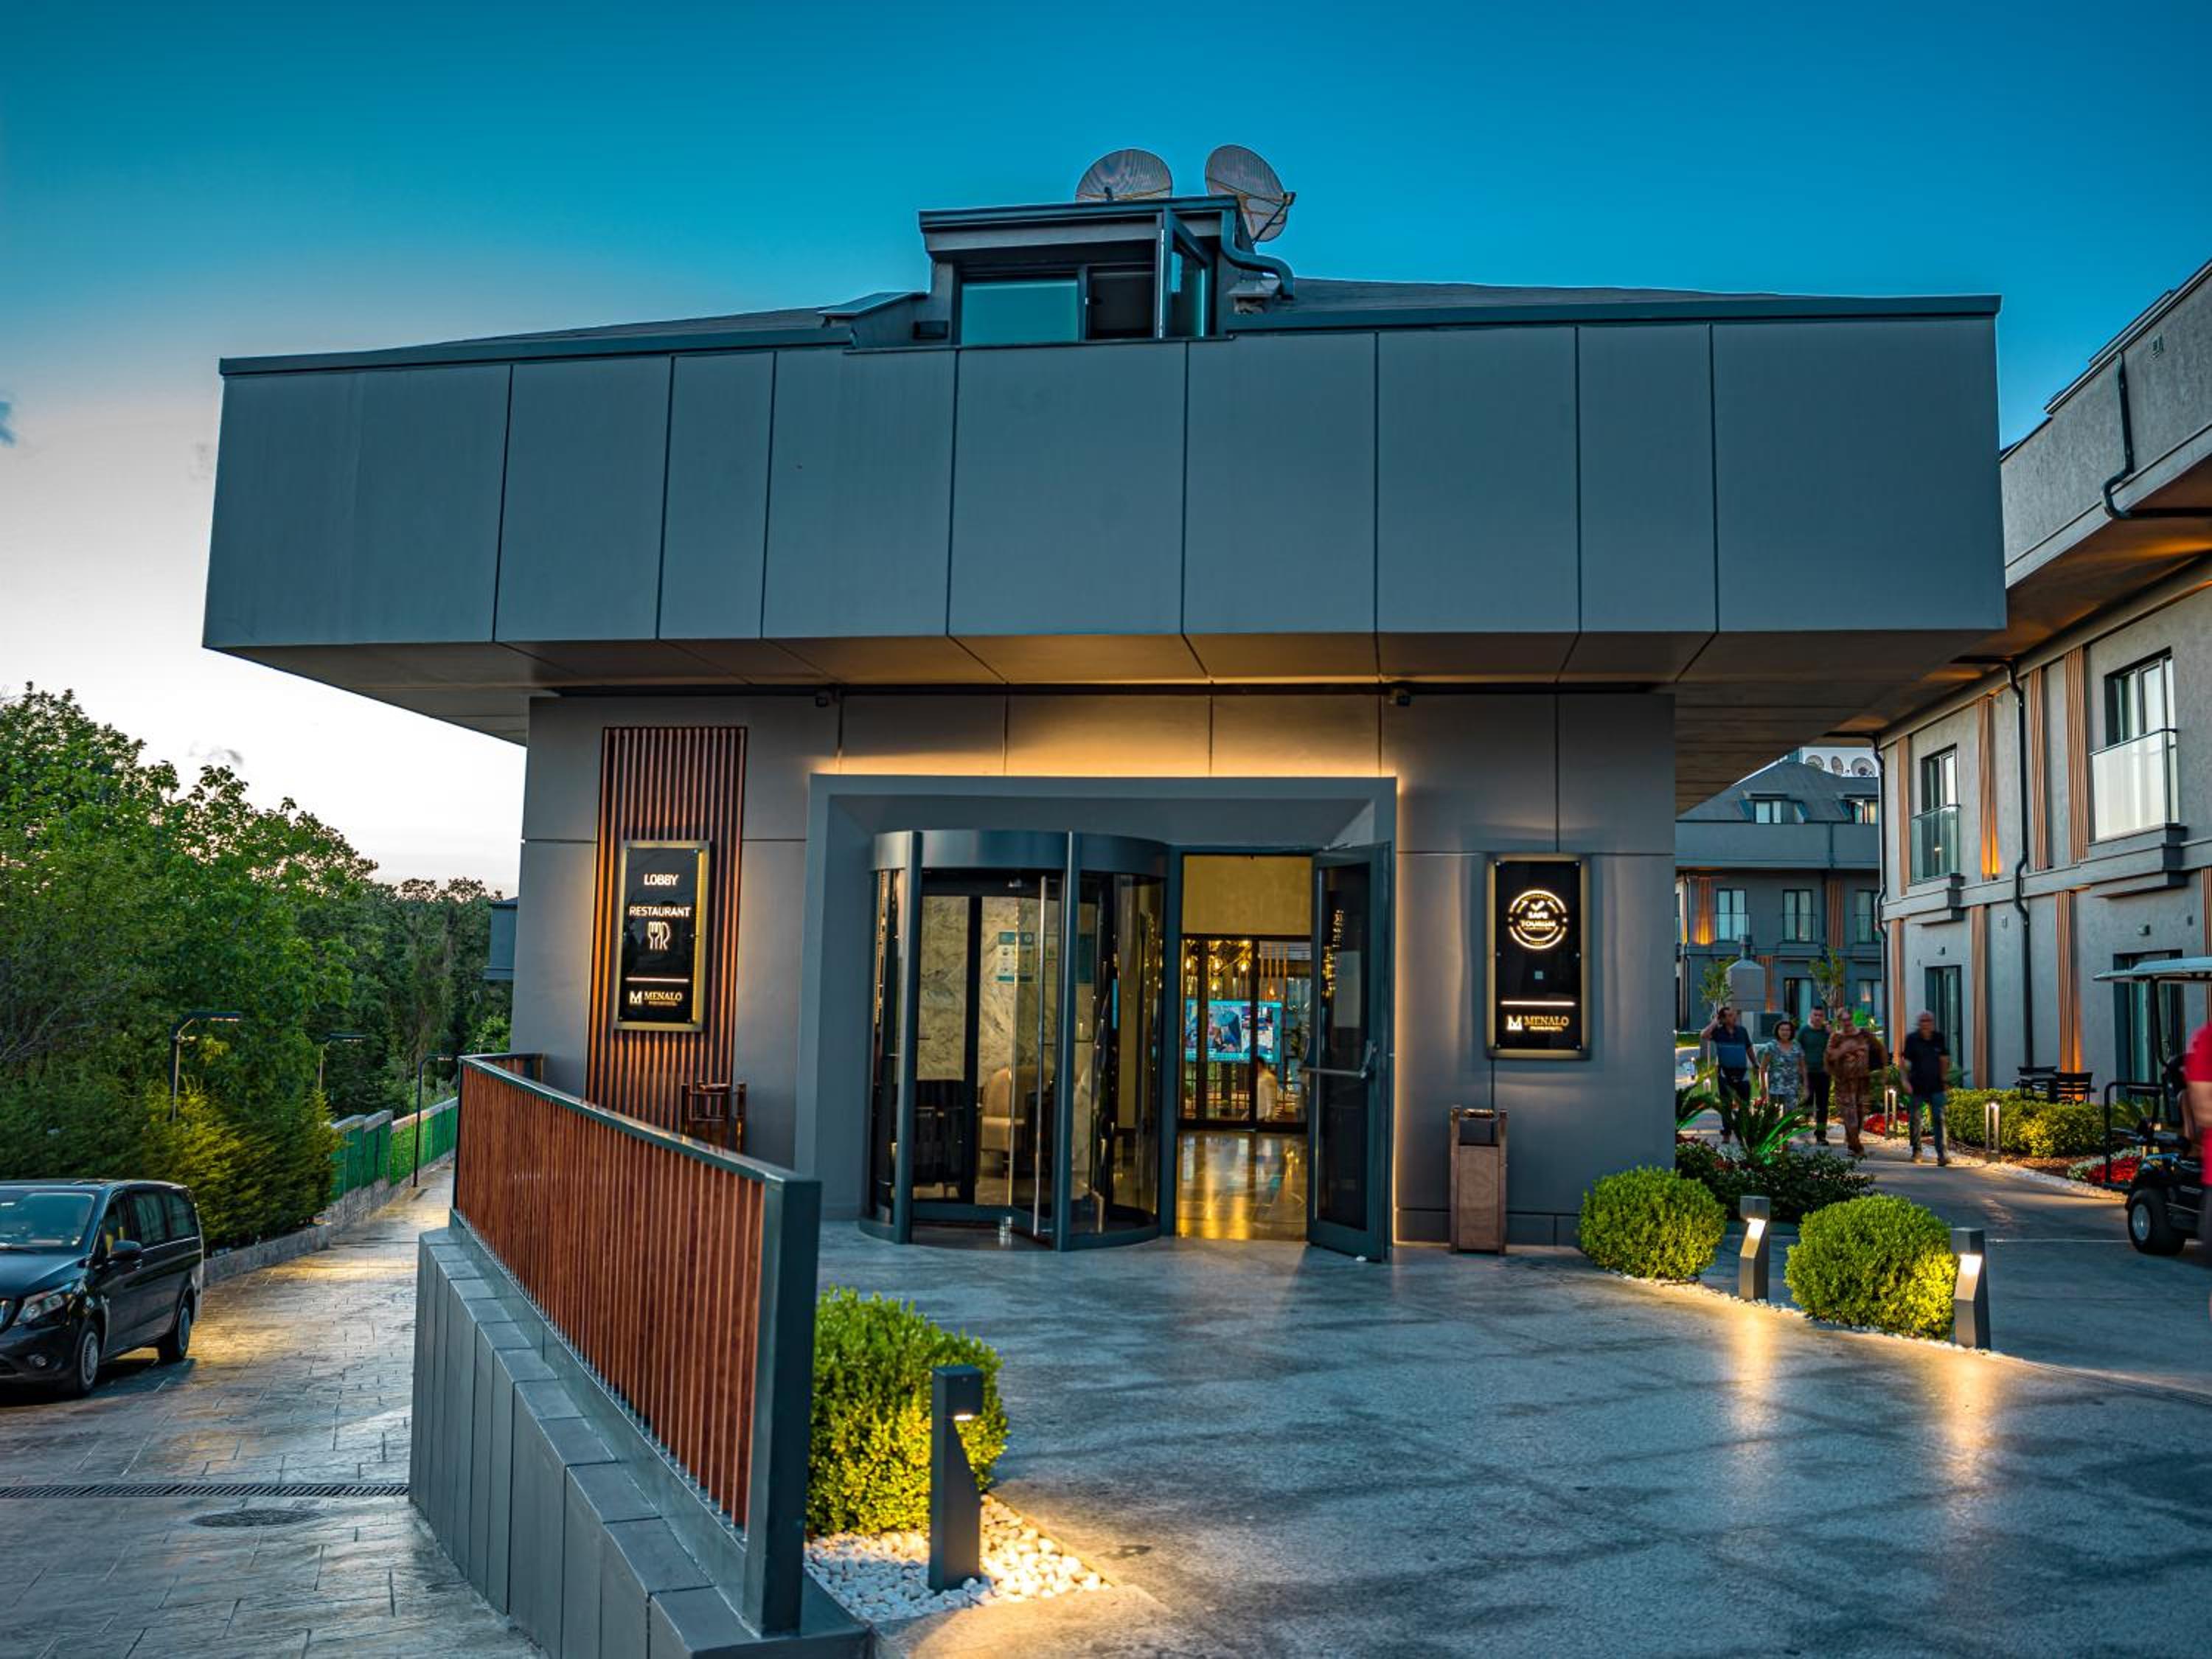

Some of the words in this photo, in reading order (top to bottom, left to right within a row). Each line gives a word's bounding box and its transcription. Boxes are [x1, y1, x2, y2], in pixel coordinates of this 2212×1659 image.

[644, 874, 679, 886] LOBBY
[629, 906, 692, 917] RESTAURANT
[644, 990, 683, 1002] MENALO
[1523, 1015, 1570, 1027] MENALO
